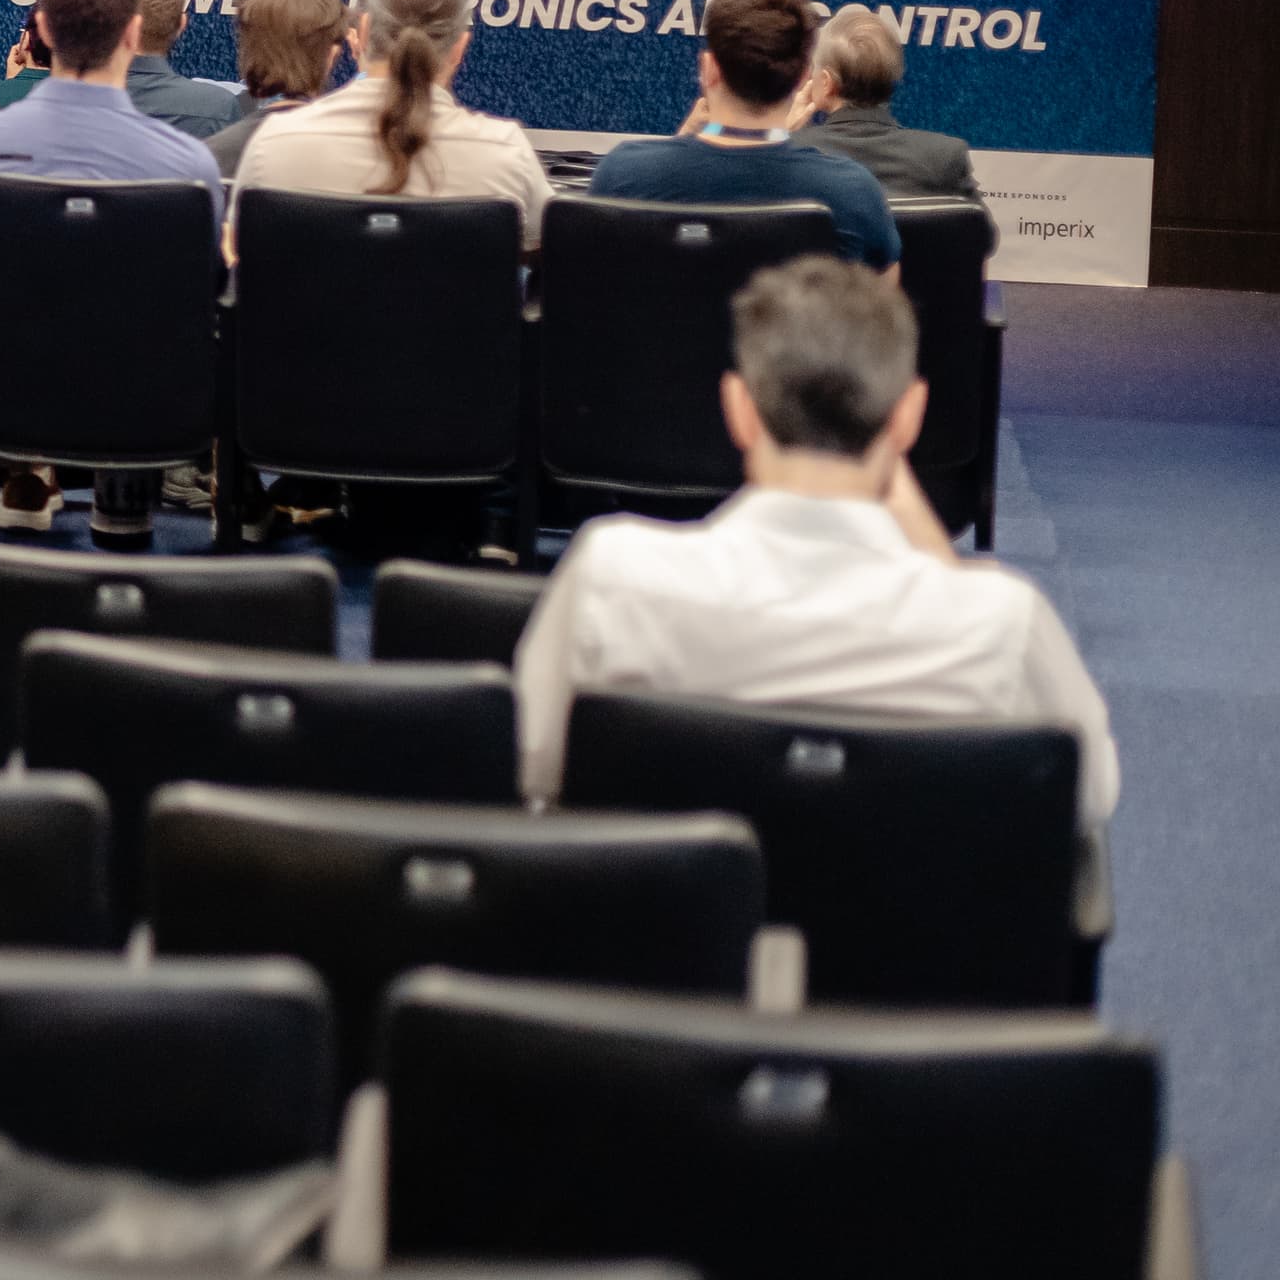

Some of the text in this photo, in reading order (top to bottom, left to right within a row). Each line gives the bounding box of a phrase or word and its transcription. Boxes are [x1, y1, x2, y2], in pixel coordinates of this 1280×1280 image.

[811, 1, 1047, 52] NTROL
[983, 191, 1068, 201] ONZE SPONSORS
[1018, 217, 1096, 241] imperix
